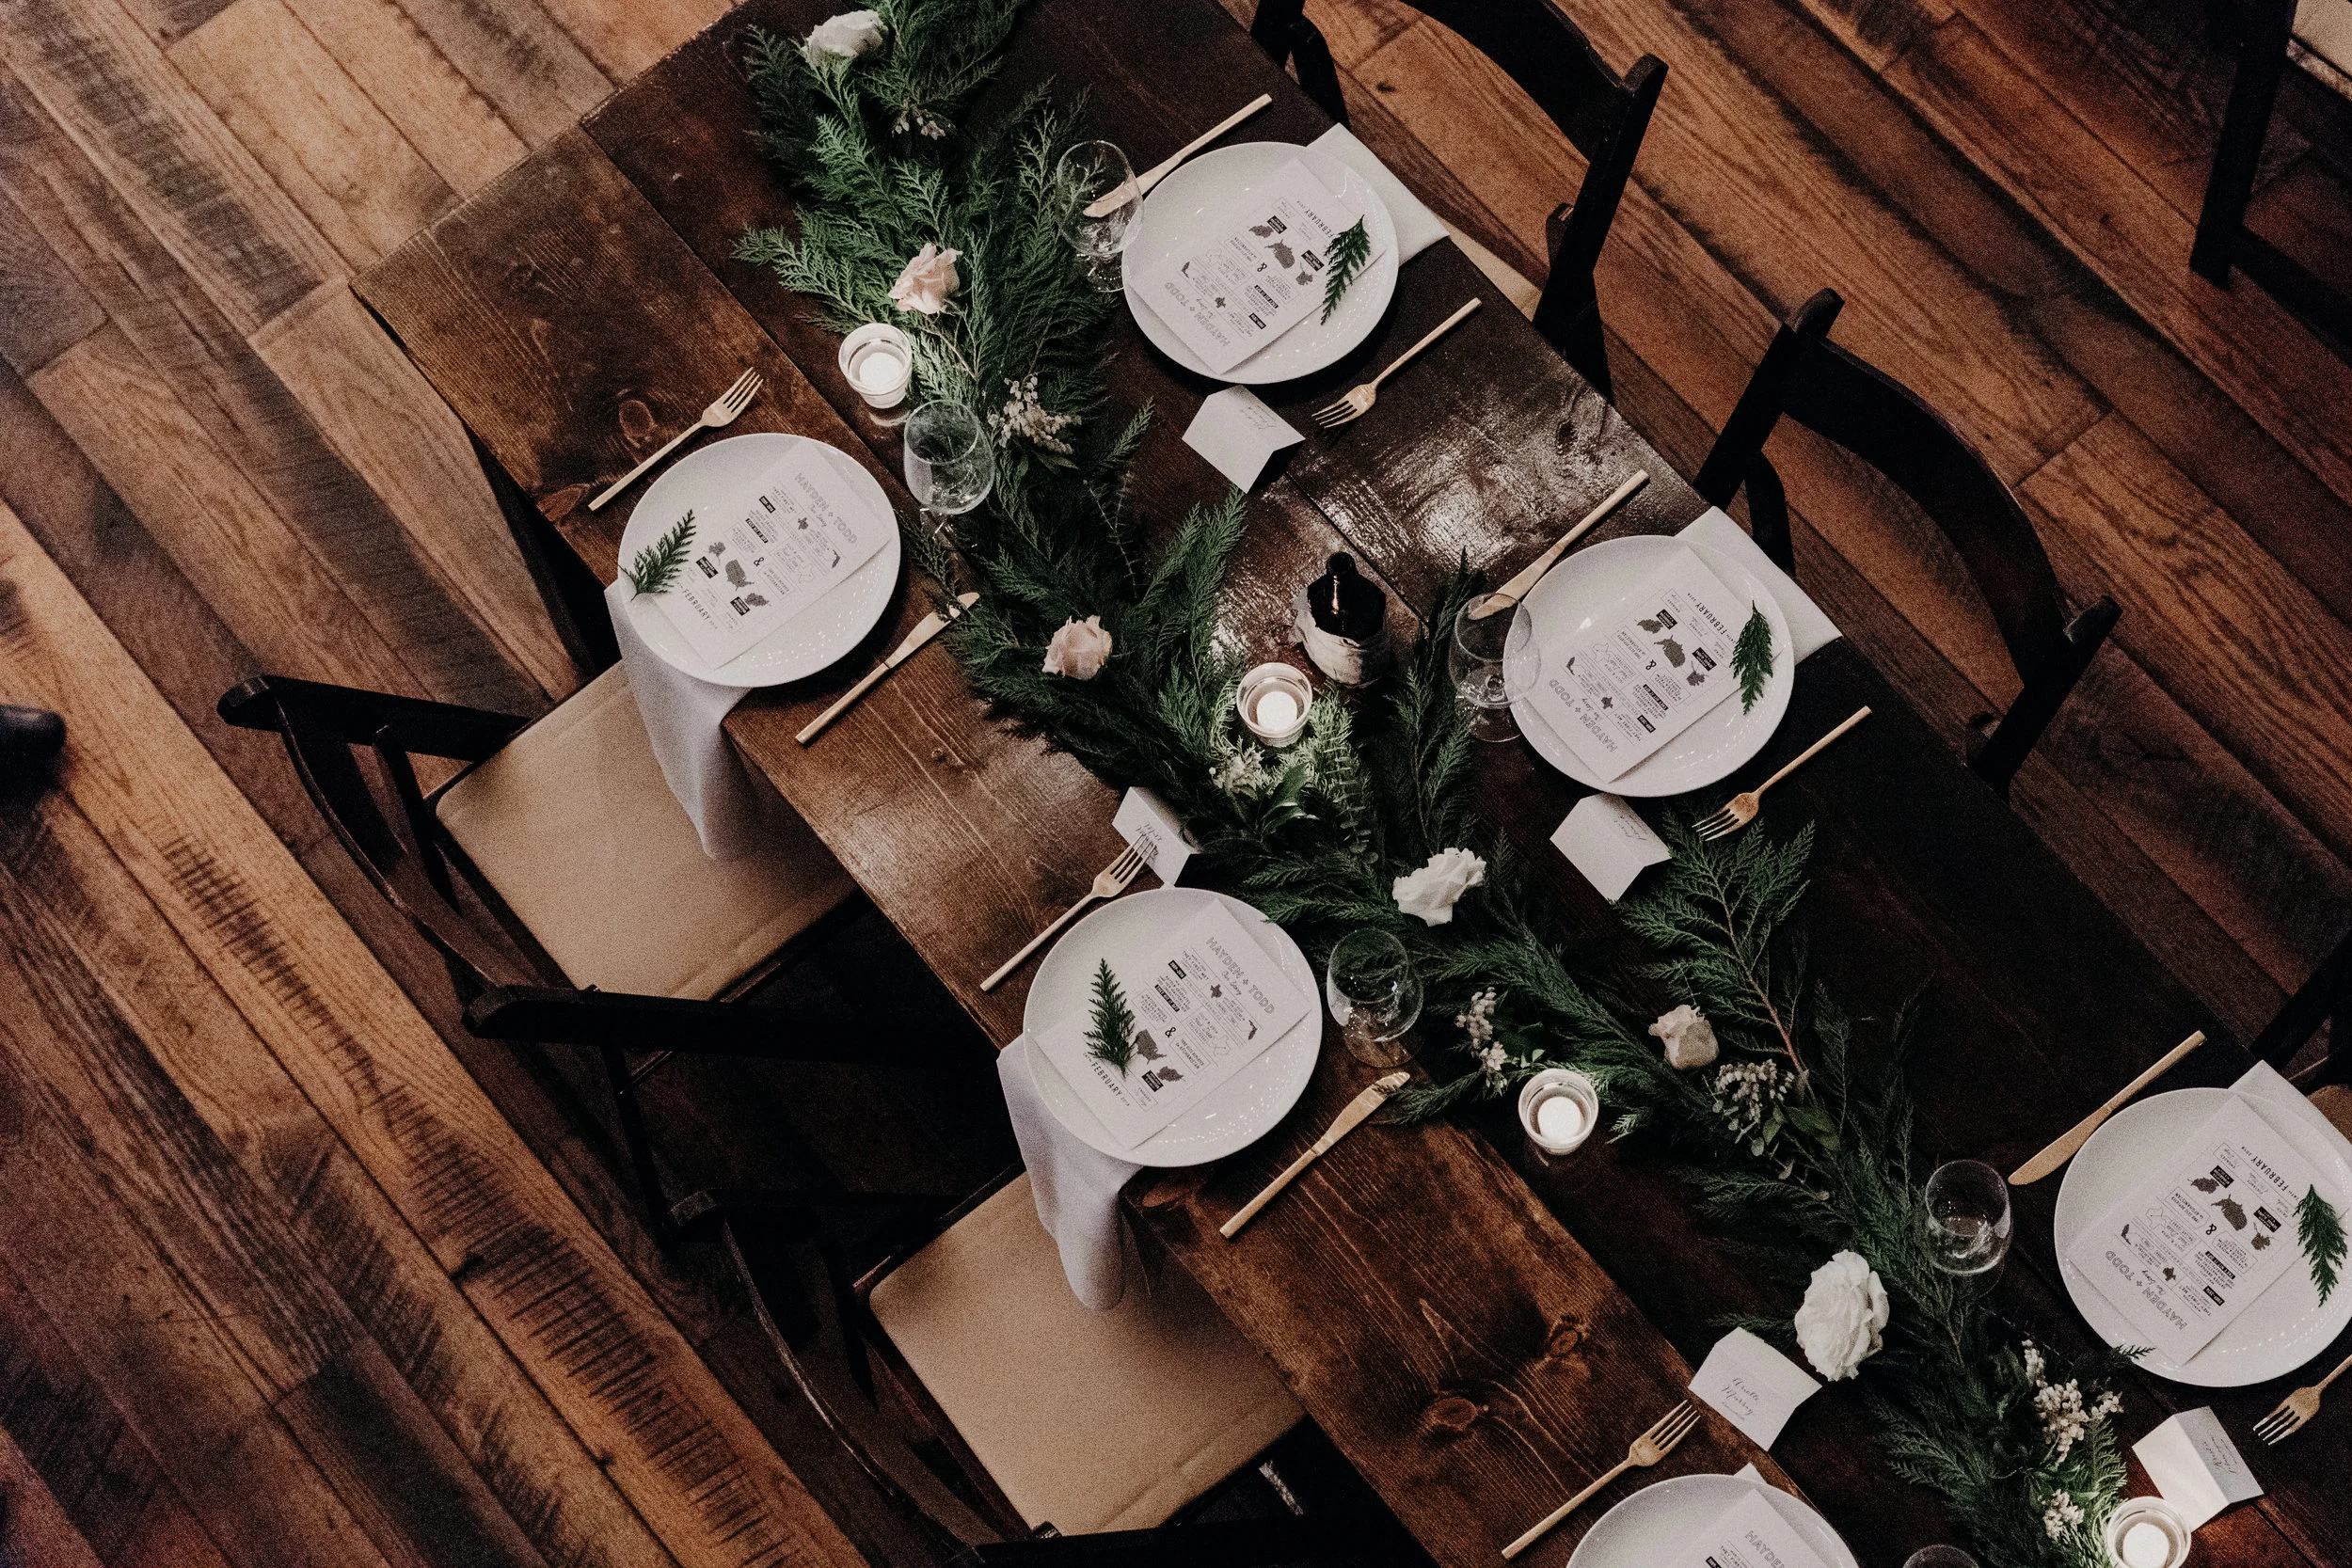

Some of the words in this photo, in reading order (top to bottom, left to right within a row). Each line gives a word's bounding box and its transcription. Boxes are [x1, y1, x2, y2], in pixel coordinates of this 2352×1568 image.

[1303, 207, 1335, 238] FEBRUARY
[1257, 262, 1267, 272] &
[1162, 279, 1191, 307] TODD
[1192, 310, 1231, 347] HAYDEN
[793, 472, 830, 512] HAYDEN
[831, 515, 858, 545] TODD
[754, 557, 765, 567] &
[680, 588, 711, 621] FEBRUARY
[1694, 600, 1727, 635] FEBRUARY
[1645, 659, 1657, 671] &
[1547, 677, 1577, 707] TODD
[1579, 712, 1618, 753] HAYDEN
[1204, 936, 1245, 979] HAYDEN
[1246, 983, 1276, 1015] TODD
[1165, 1026, 1176, 1037] &
[1089, 1061, 1123, 1098] FEBRUARY
[2249, 1153, 2289, 1192] FEBRUARY
[2205, 1223, 2217, 1235] &
[2103, 1248, 2137, 1281] TODD
[2141, 1286, 2187, 1331] HAYDEN
